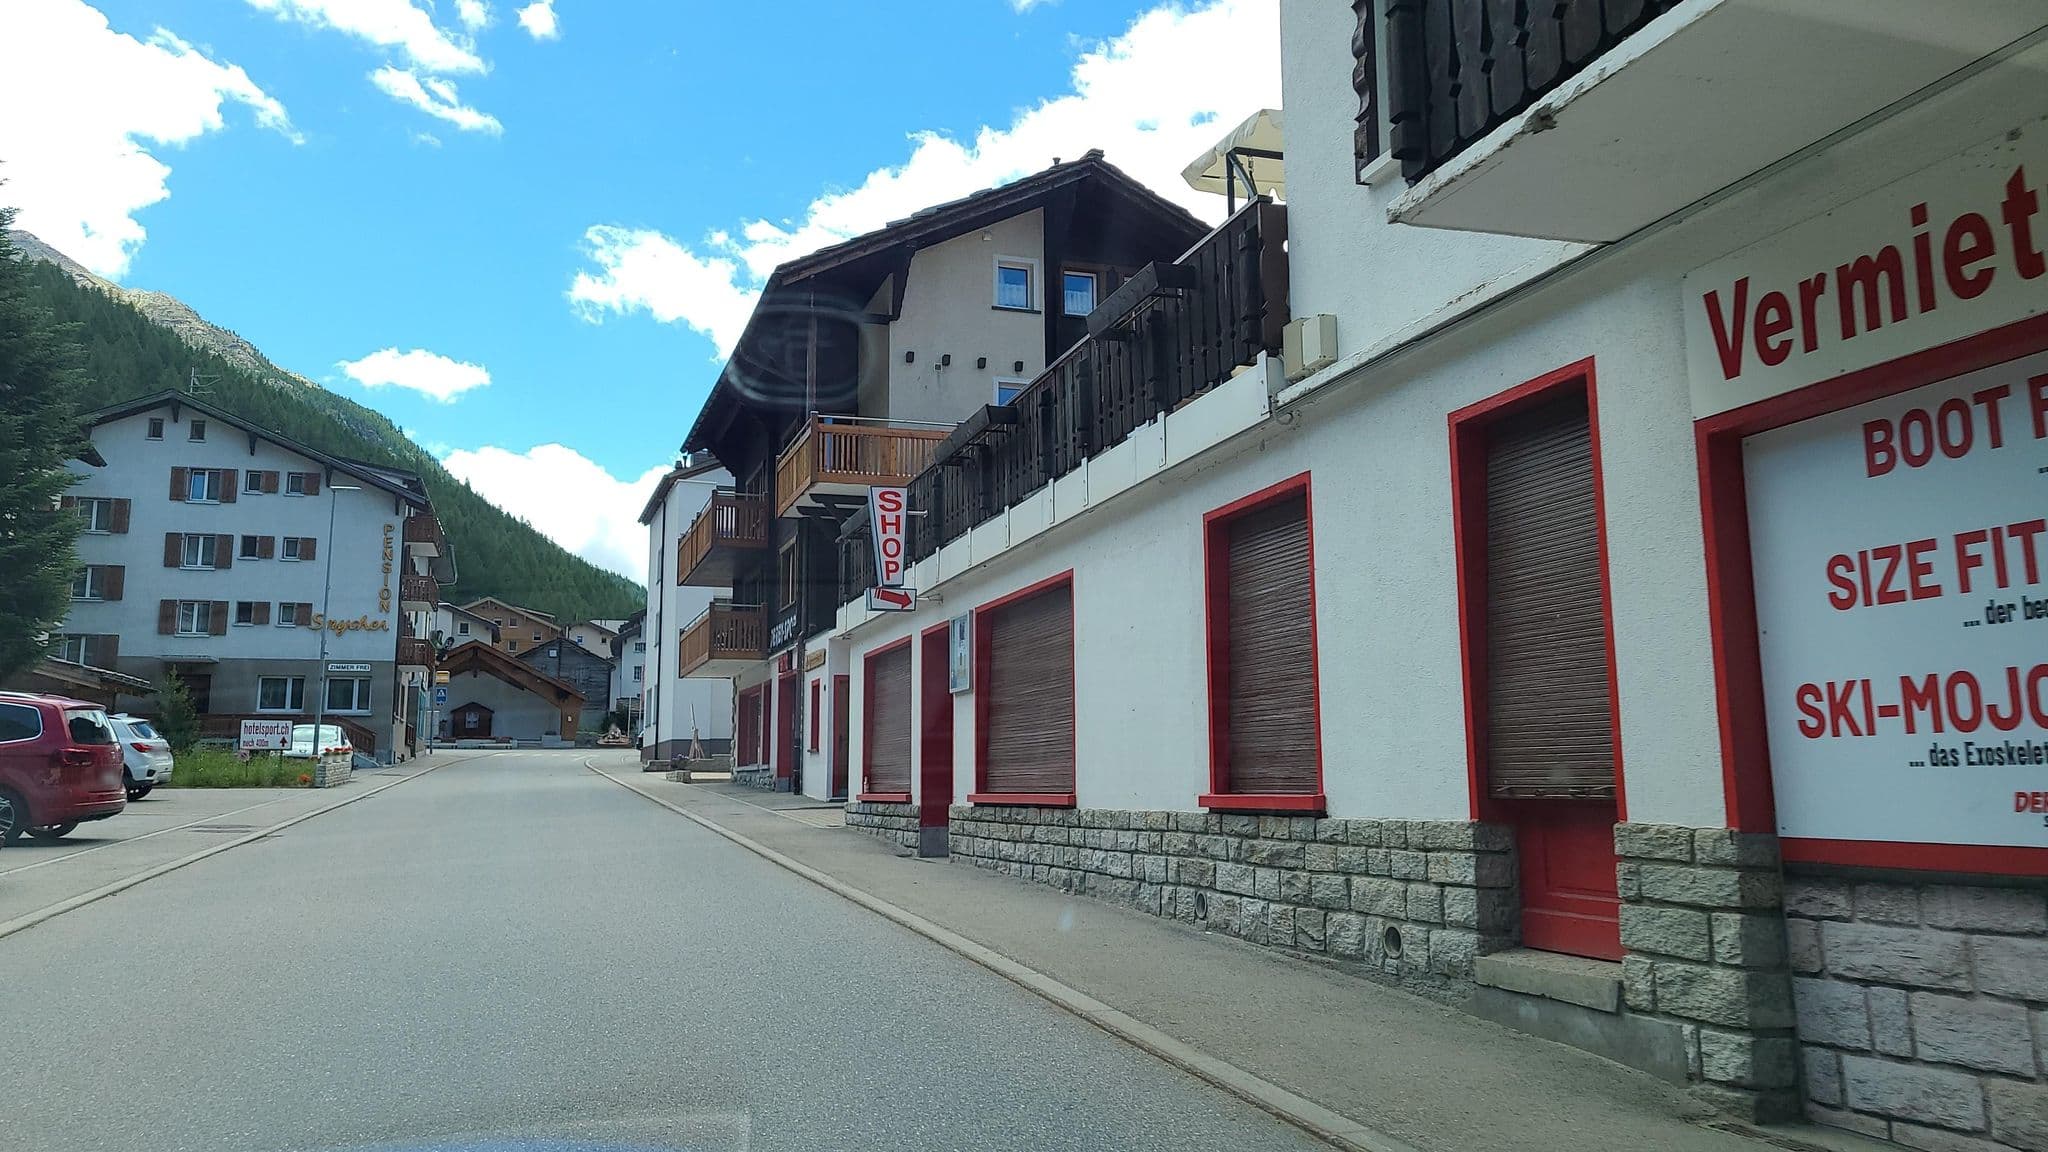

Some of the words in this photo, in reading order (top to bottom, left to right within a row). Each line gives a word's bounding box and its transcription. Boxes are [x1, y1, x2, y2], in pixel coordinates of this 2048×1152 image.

[1703, 164, 2047, 381] Vermiet
[1863, 384, 2011, 478] BOOT
[378, 523, 395, 613] PENSION
[879, 491, 902, 580] SHOP
[1826, 538, 1943, 611] SIZE
[1954, 518, 2047, 594] FIT
[1985, 599, 2016, 625] der
[243, 721, 289, 737] hotelsport.ch
[1929, 742, 1960, 767] das
[2015, 791, 2048, 813] DE
